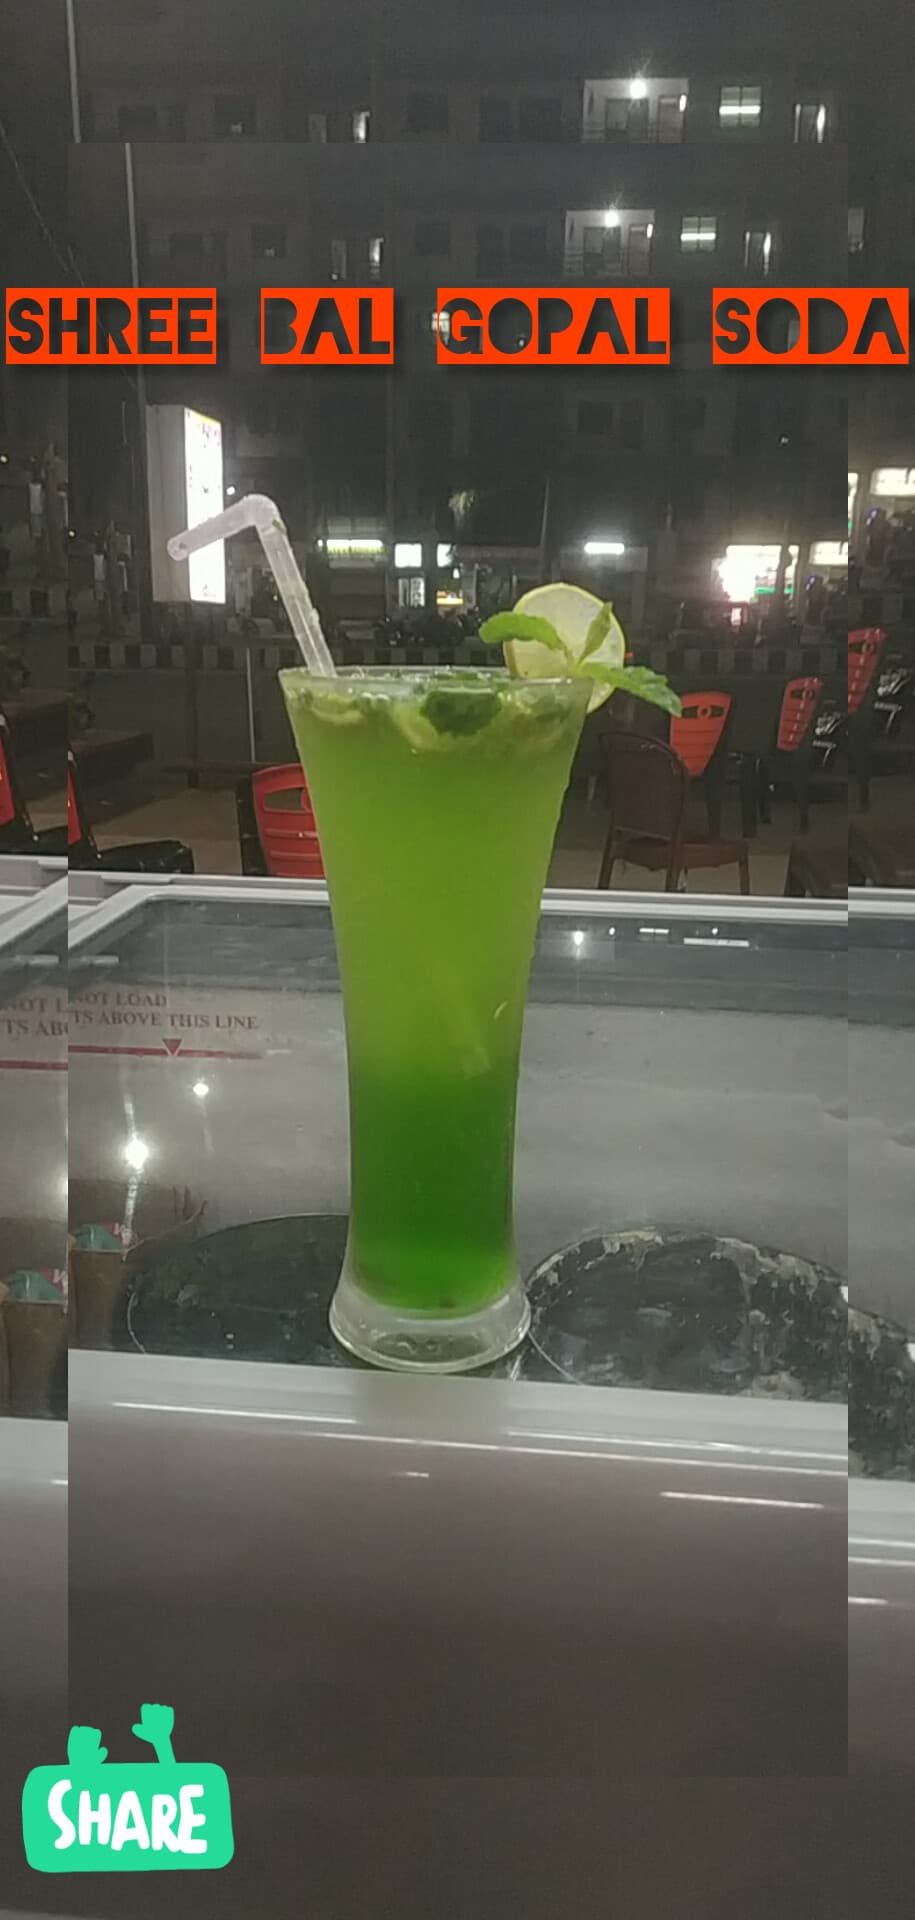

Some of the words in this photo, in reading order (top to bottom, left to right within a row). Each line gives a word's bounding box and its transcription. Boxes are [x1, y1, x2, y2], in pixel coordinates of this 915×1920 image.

[115, 992, 168, 1007] LOAD
[98, 1010, 161, 1026] ABOVE
[168, 1013, 210, 1028] THIS
[215, 1014, 260, 1030] LINE
